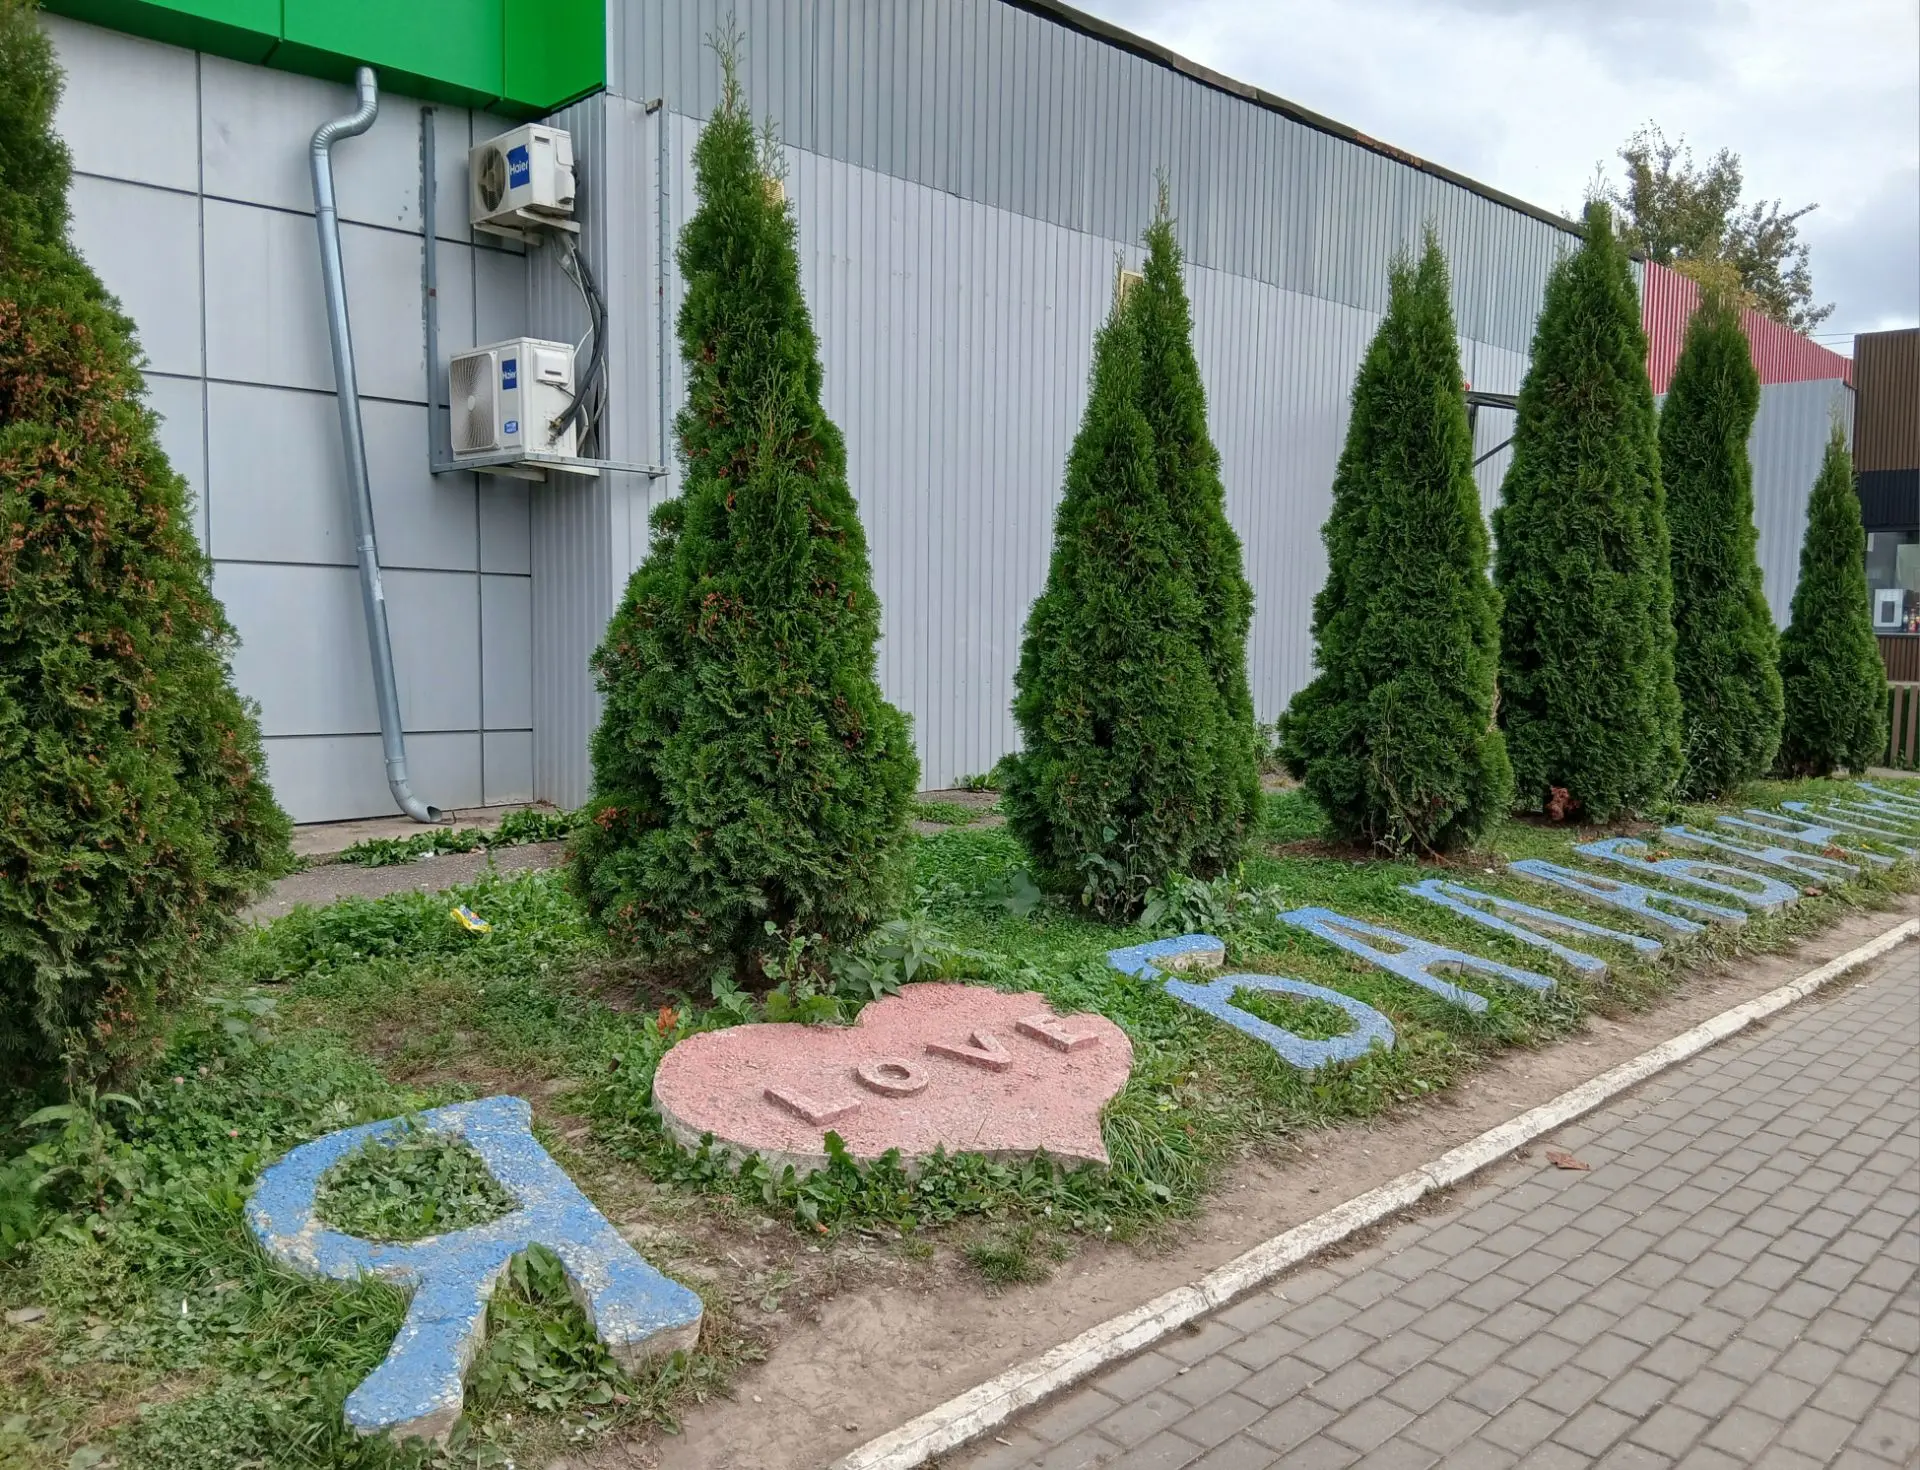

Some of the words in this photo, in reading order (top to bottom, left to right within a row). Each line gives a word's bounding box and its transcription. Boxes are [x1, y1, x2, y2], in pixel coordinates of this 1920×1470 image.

[510, 160, 529, 176] Haier
[764, 1013, 1100, 1126] LOVE
[246, 1095, 704, 1434] Я
